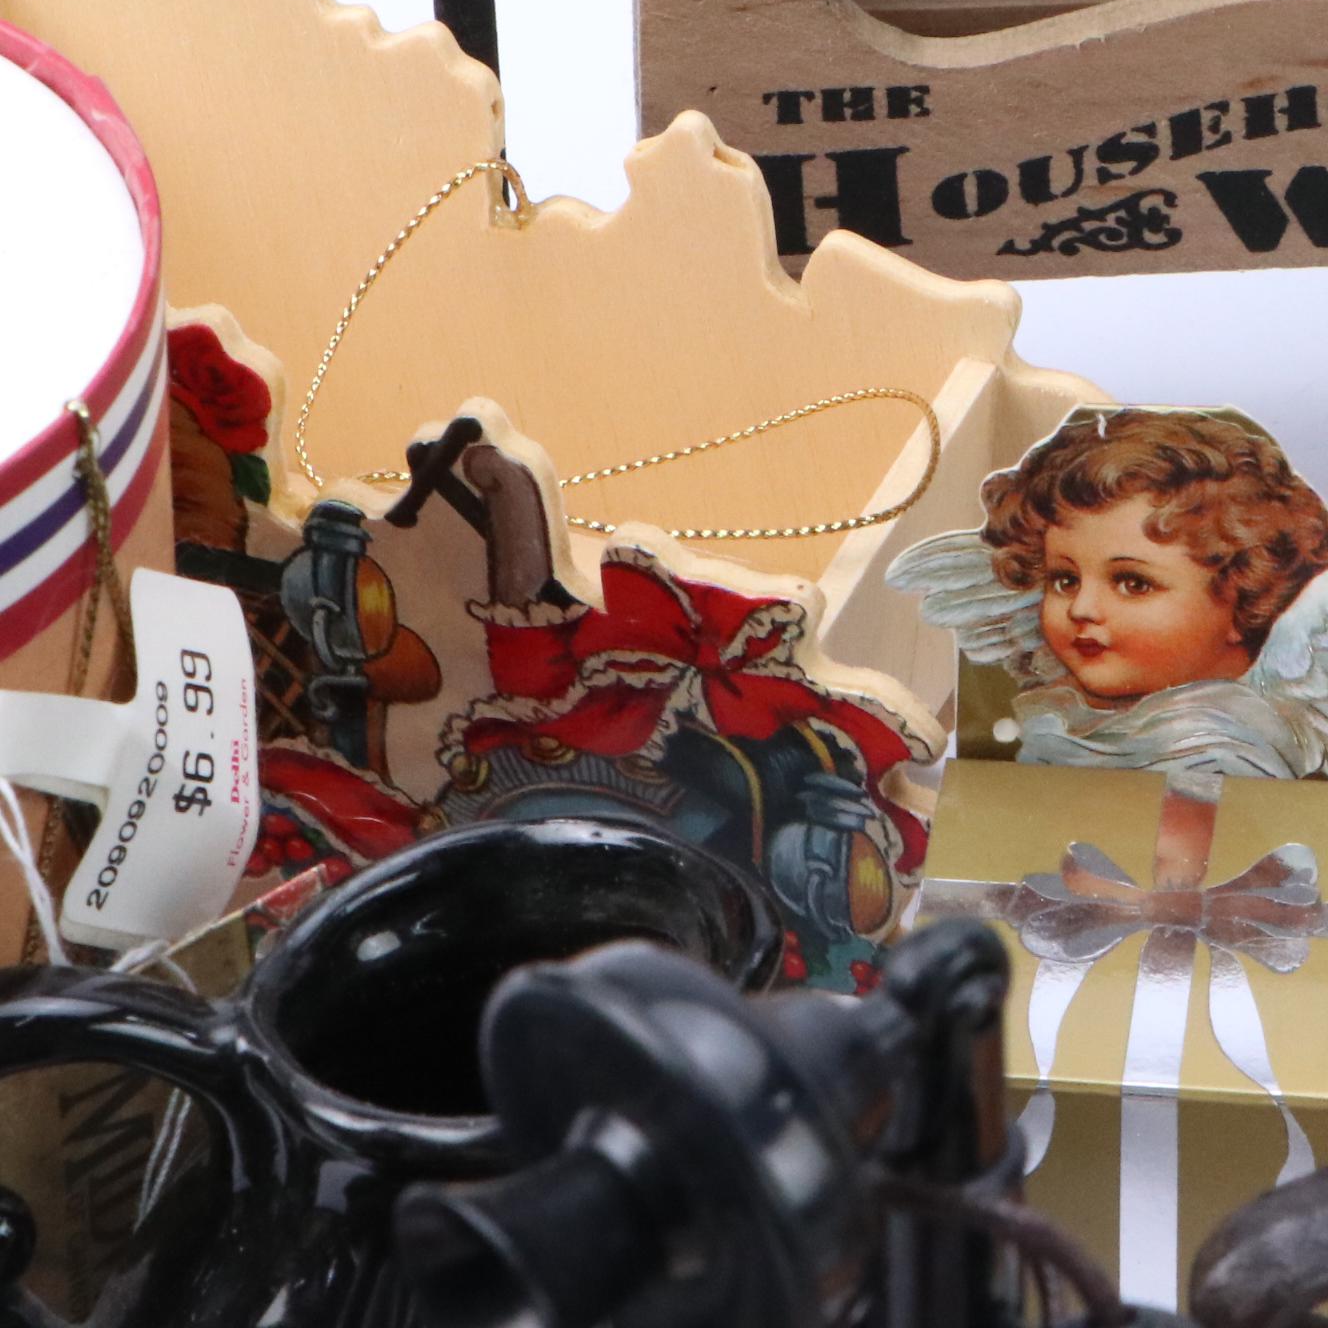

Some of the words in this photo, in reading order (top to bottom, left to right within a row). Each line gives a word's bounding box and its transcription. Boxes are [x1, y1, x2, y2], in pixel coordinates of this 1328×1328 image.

[762, 85, 931, 125] THE
[86, 680, 169, 911] 2090920009
[227, 799, 250, 868] Flower
[239, 678, 250, 762] Garden
